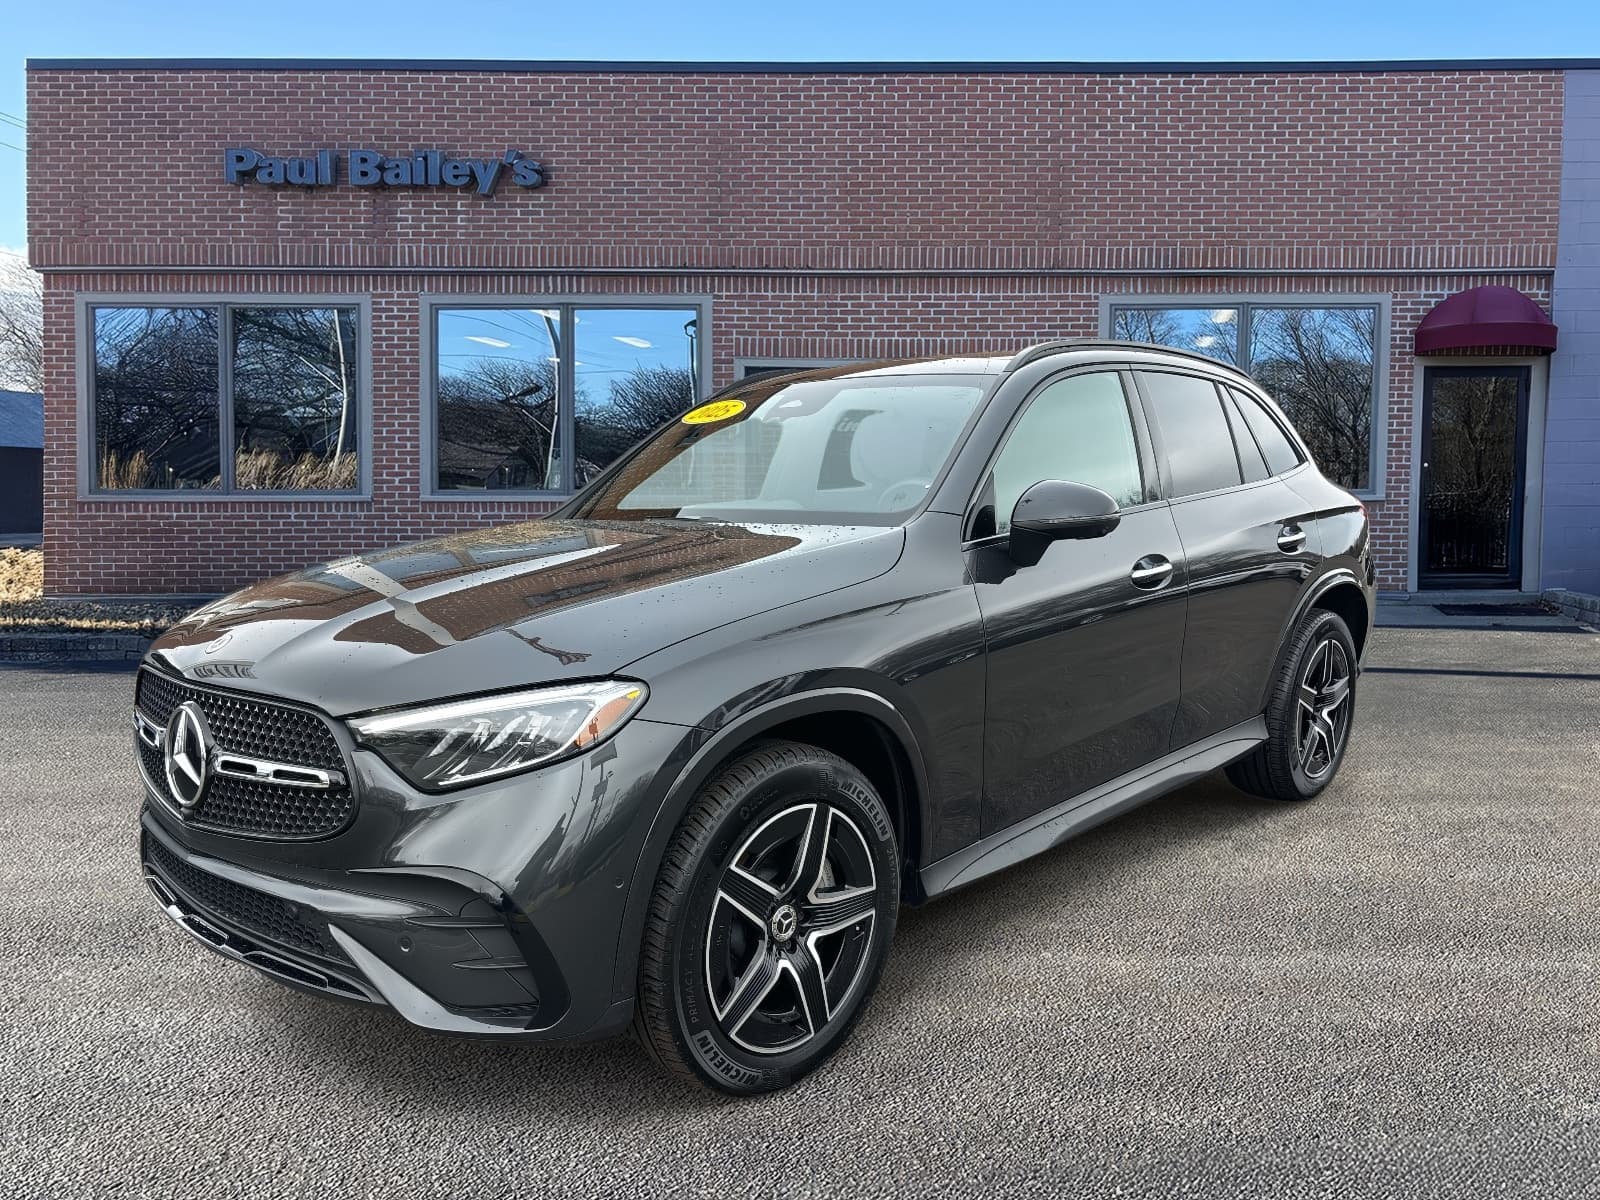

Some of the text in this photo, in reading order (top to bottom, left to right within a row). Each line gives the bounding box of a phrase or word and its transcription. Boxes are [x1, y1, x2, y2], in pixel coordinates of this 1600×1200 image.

[224, 148, 545, 196] Paul Bailey's
[841, 782, 889, 837] MICHELIN
[684, 967, 699, 1024] PRIMACY
[697, 1034, 761, 1087] MICHELIN
